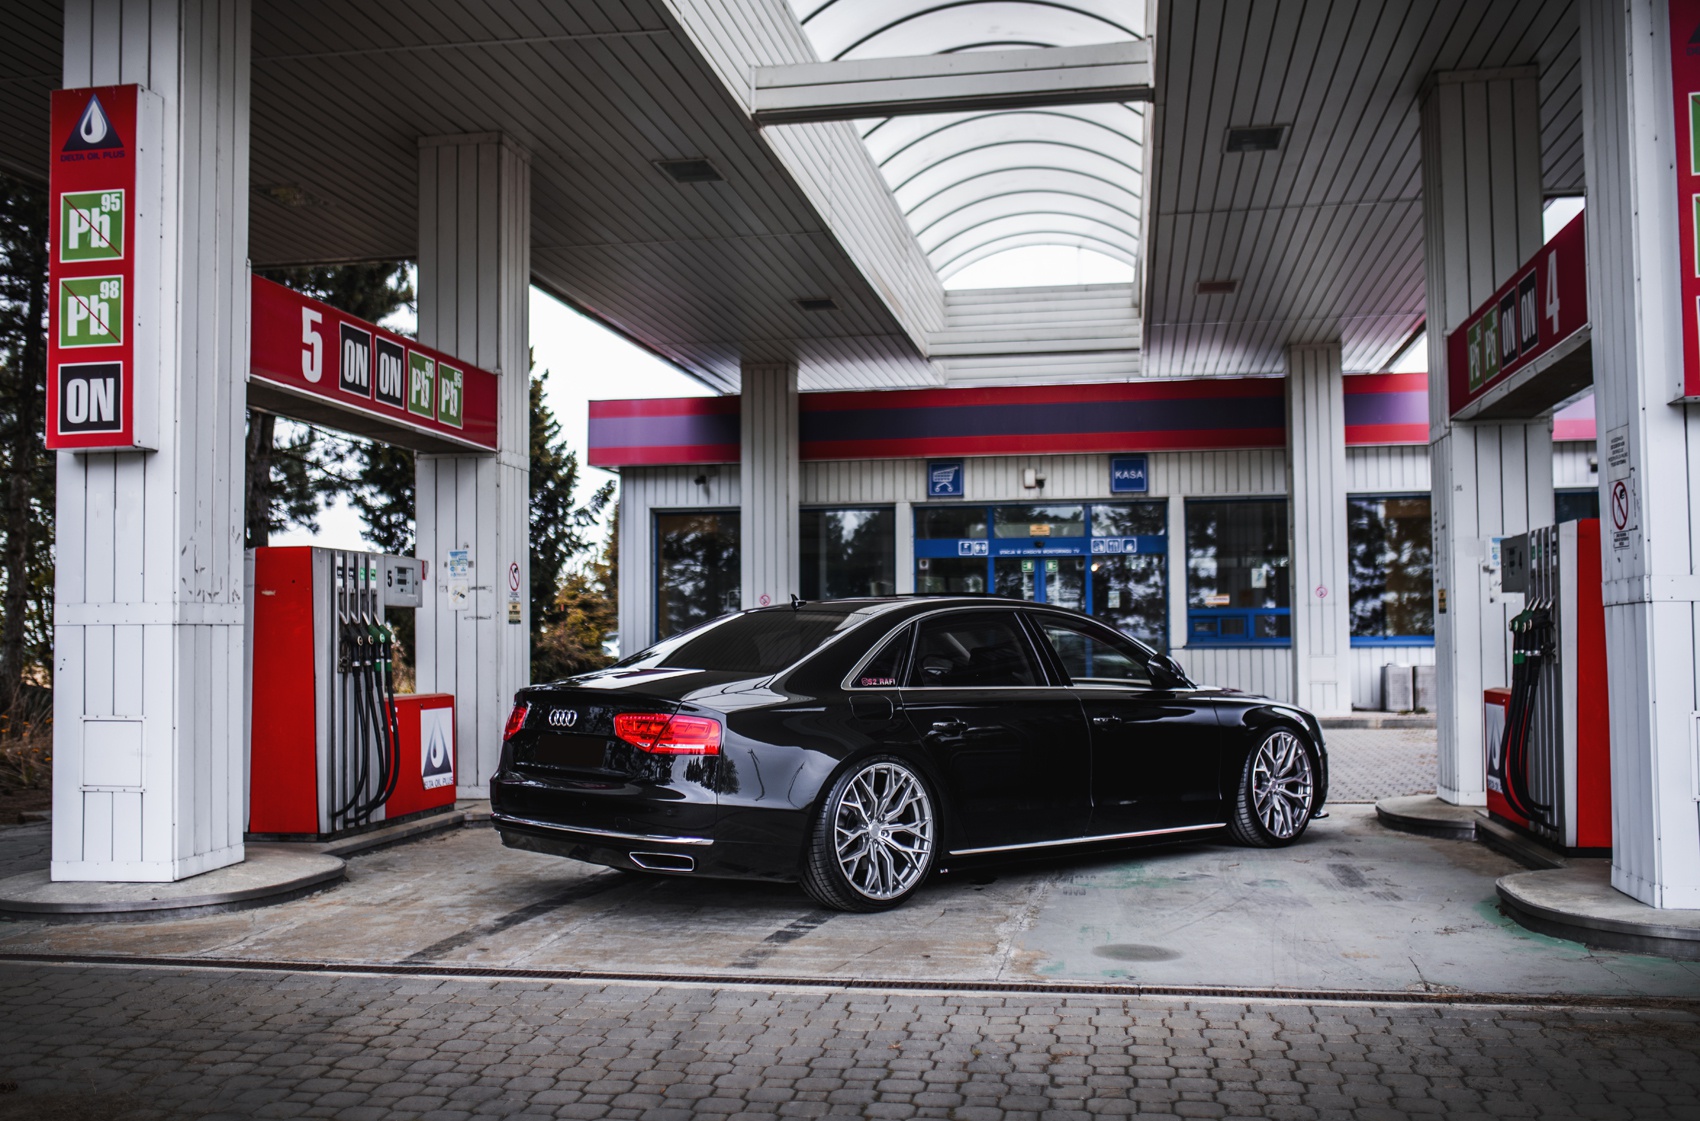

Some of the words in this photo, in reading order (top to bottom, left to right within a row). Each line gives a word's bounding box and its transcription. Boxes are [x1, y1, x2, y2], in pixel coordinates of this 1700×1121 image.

[60, 153, 85, 162] DELTA
[87, 152, 100, 161] OIL
[102, 150, 125, 159] PLUS
[1502, 305, 1516, 357] ON
[1521, 287, 1536, 343] ON
[1546, 249, 1560, 335] 4
[302, 306, 323, 383] 5
[343, 339, 368, 388] ON
[379, 352, 402, 399] ON
[66, 378, 115, 424] ON
[1114, 470, 1144, 479] KASA
[387, 570, 392, 587] 5
